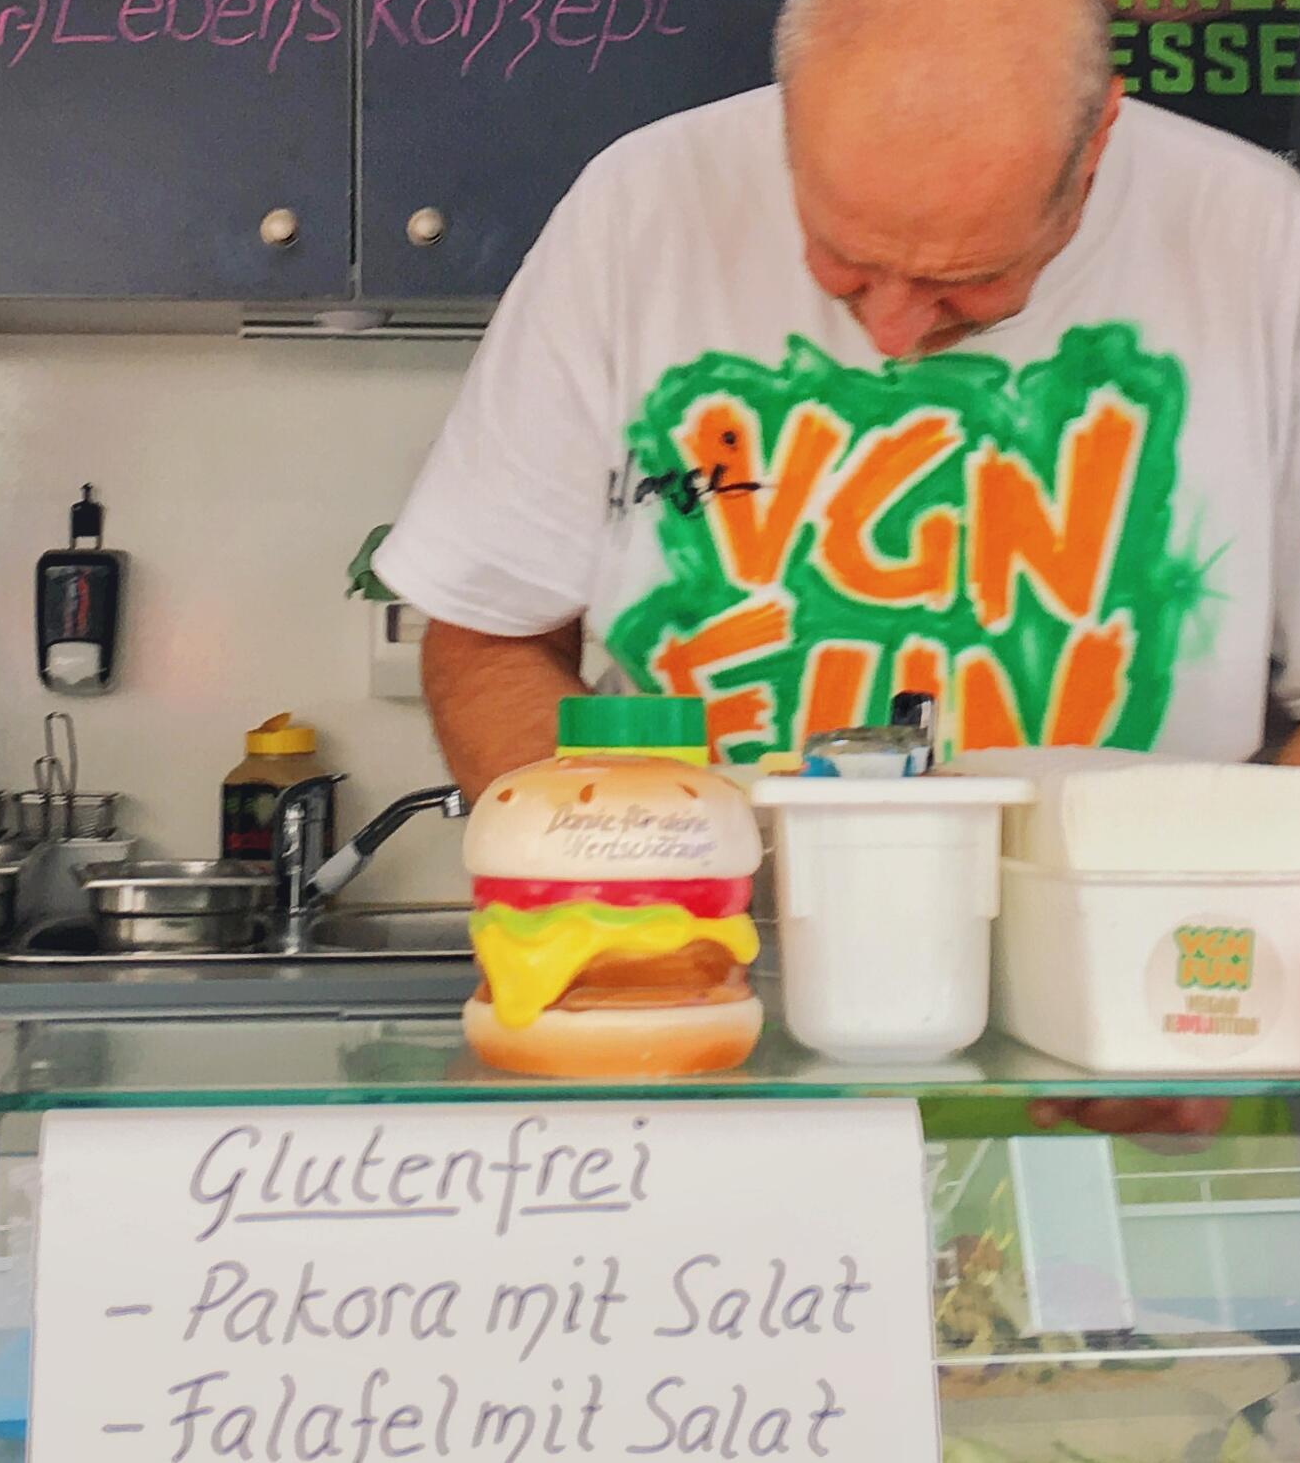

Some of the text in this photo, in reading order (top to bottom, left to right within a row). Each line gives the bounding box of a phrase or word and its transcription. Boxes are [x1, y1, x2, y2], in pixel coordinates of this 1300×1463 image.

[671, 384, 1149, 632] VGN
[189, 1117, 653, 1241] Glutenfrei
[182, 1253, 873, 1362] Pakora mit Salat
[168, 1368, 847, 1463] Falafel mit Salat
